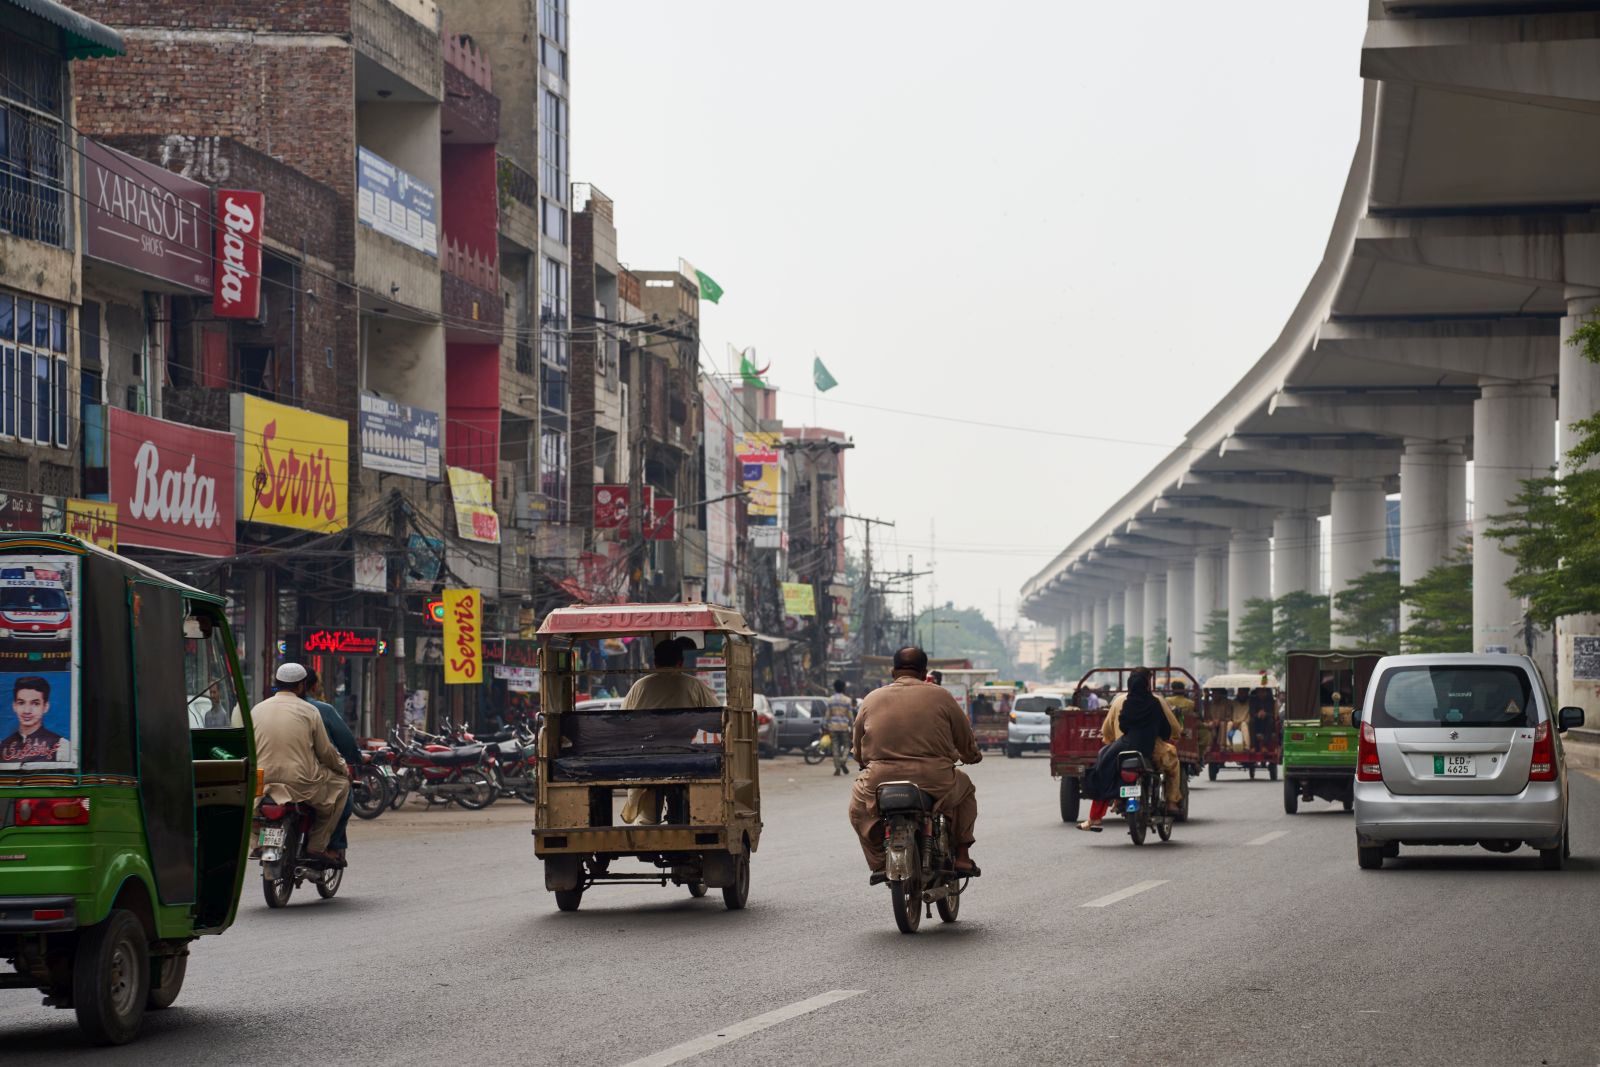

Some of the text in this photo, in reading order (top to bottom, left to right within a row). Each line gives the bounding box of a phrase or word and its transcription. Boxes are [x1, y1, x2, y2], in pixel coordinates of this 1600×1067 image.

[96, 166, 201, 249] XARASOFT
[141, 234, 164, 257] SHOES
[221, 197, 255, 304] Bata
[129, 440, 217, 530] Bata
[259, 418, 337, 521] Servis
[451, 595, 476, 679] Servis
[1447, 765, 1469, 774] 4625
[1449, 756, 1465, 765] LED
